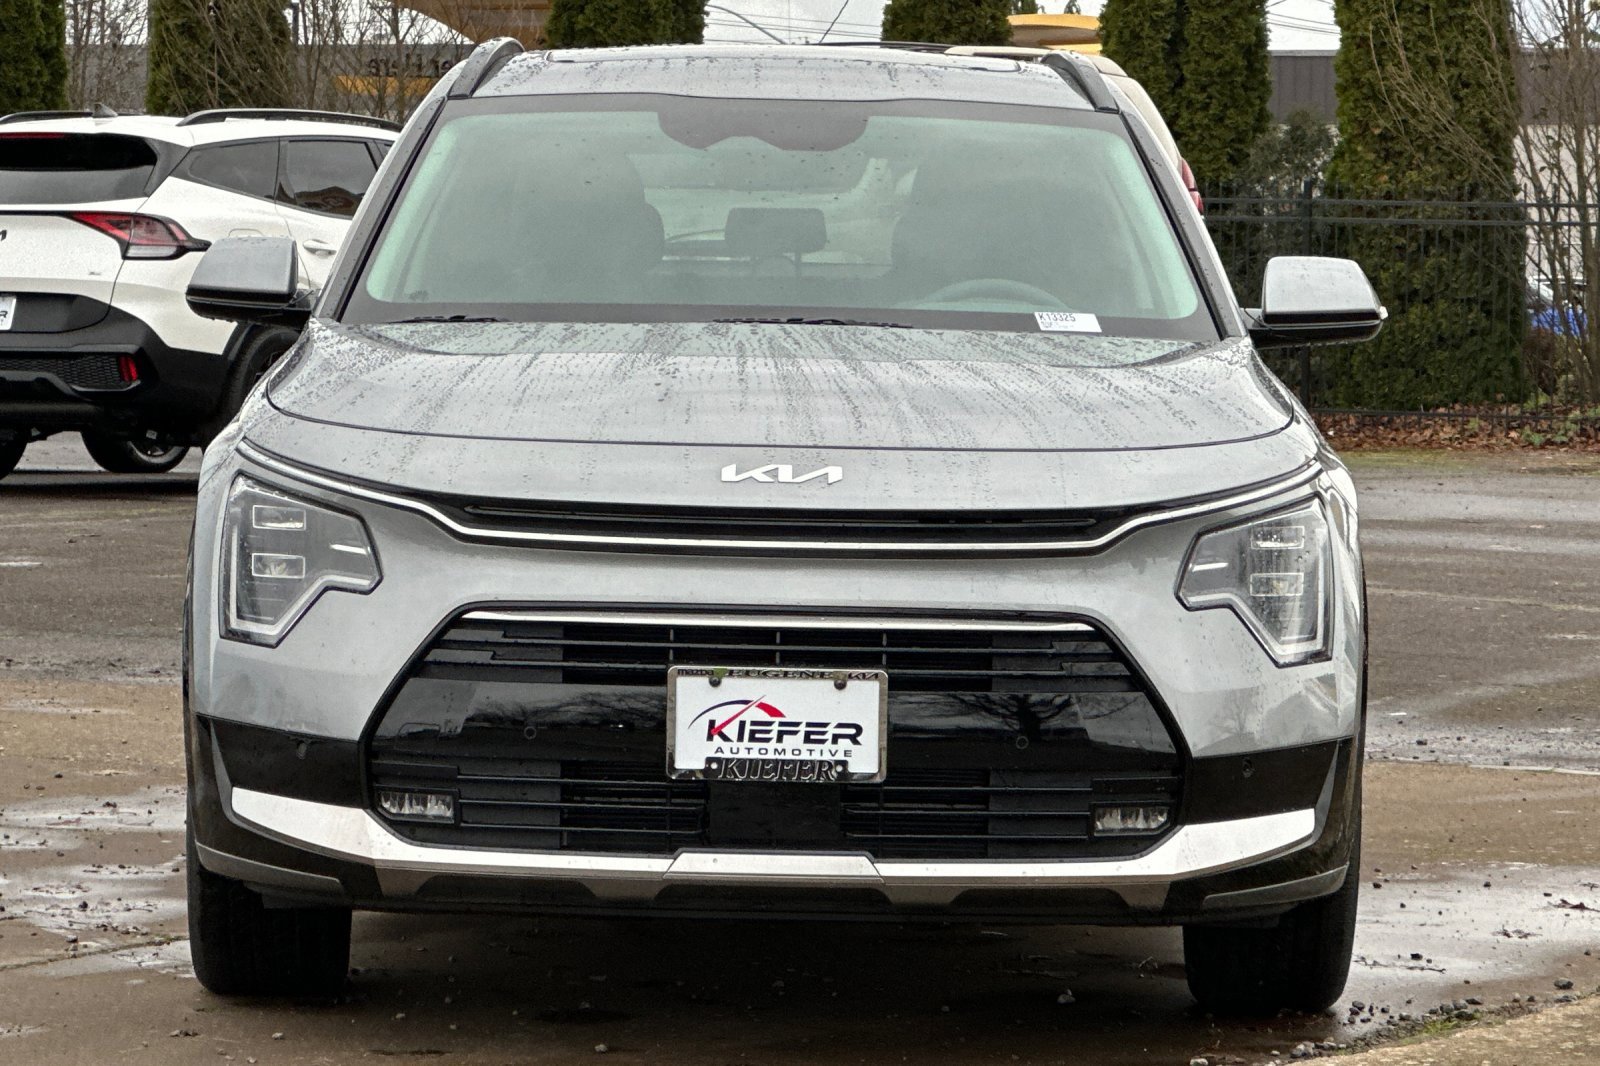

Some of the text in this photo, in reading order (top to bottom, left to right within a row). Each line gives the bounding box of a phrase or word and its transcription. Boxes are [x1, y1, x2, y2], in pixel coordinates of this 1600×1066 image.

[726, 669, 833, 680] EUGENE
[706, 719, 863, 746] KIEFER
[714, 746, 853, 758] AUTOMOTIVE
[718, 757, 837, 782] KIEFER
